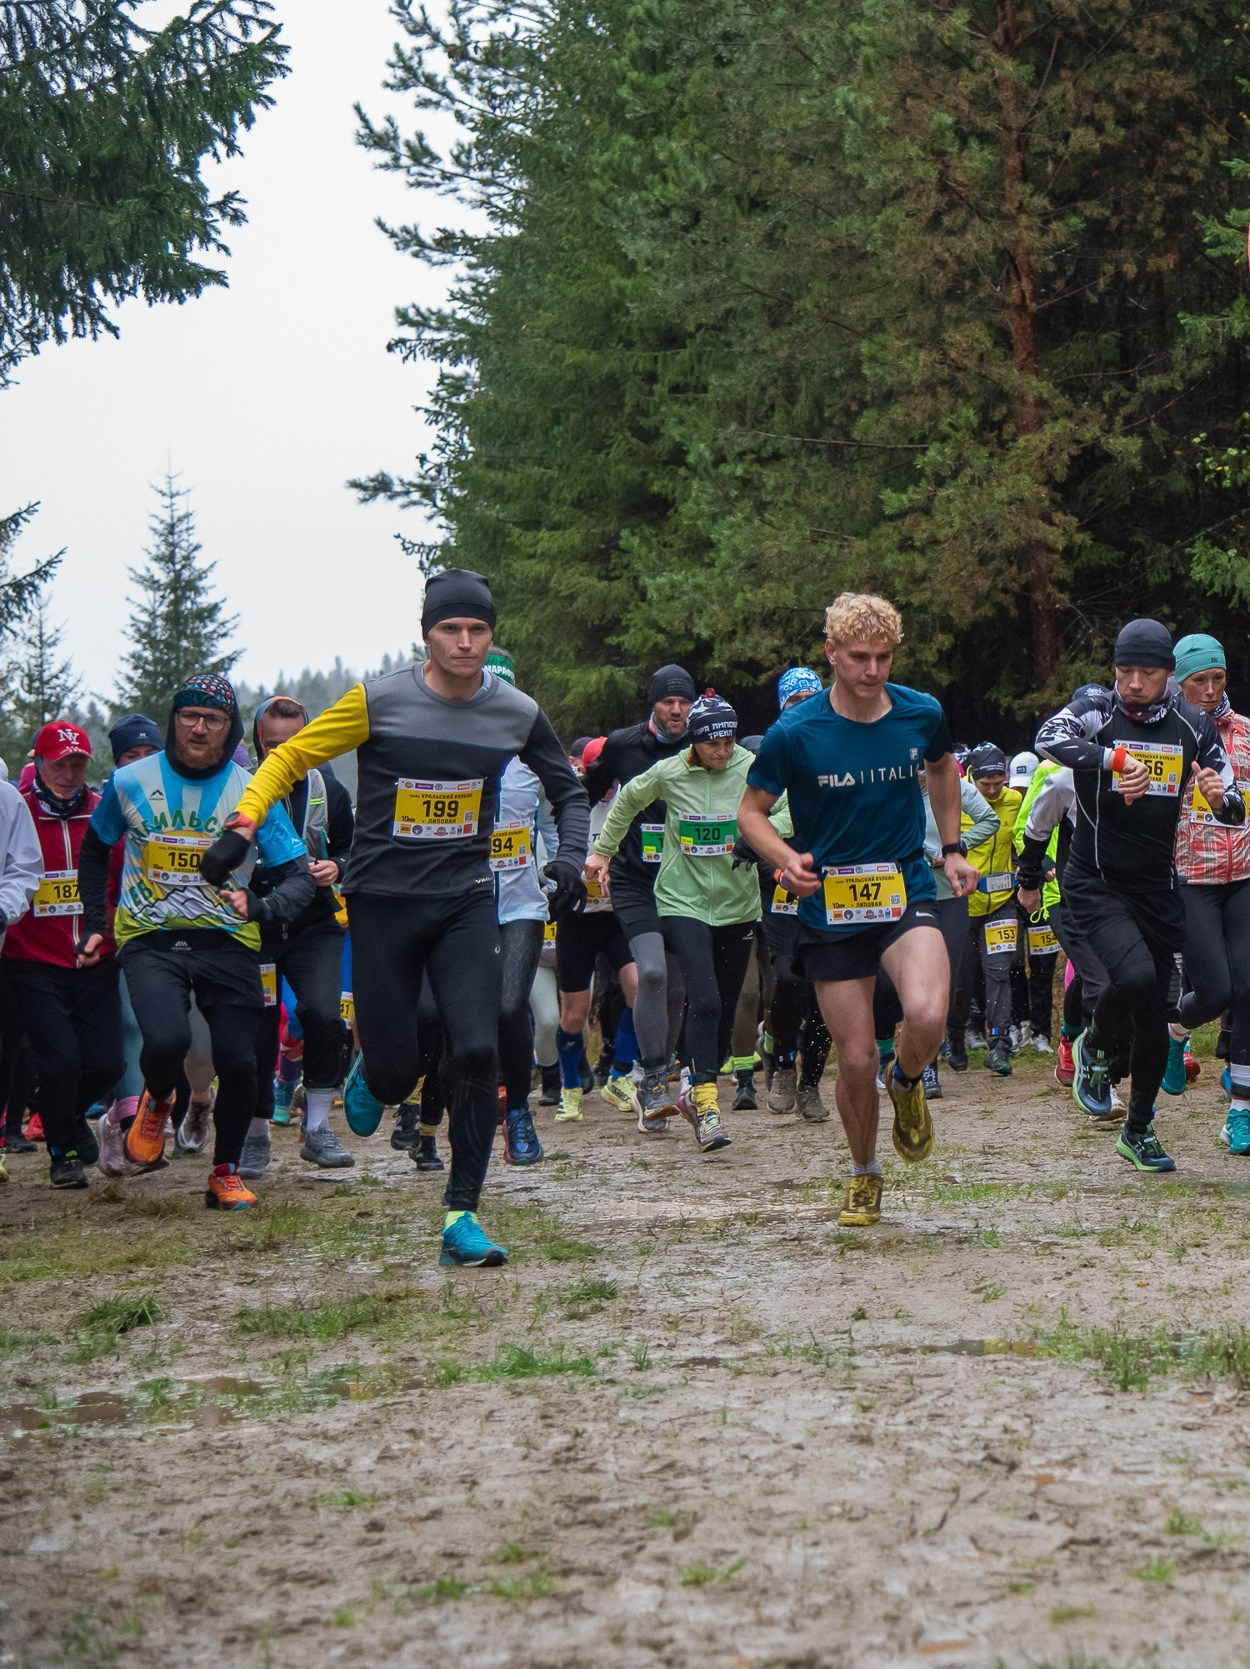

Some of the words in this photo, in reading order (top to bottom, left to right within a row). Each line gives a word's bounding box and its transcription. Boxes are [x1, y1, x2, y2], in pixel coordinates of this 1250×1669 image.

[712, 721, 738, 730] ЛИПОВ
[57, 728, 80, 745] NY
[1139, 759, 1164, 776] 56
[817, 772, 856, 788] FILA
[422, 800, 459, 818] 199
[694, 827, 721, 841] 120
[168, 852, 201, 868] 150
[845, 876, 875, 884] УРАЛЬСКИЙ
[54, 884, 80, 899] 187
[848, 883, 882, 901] 147
[997, 929, 1015, 940] 153
